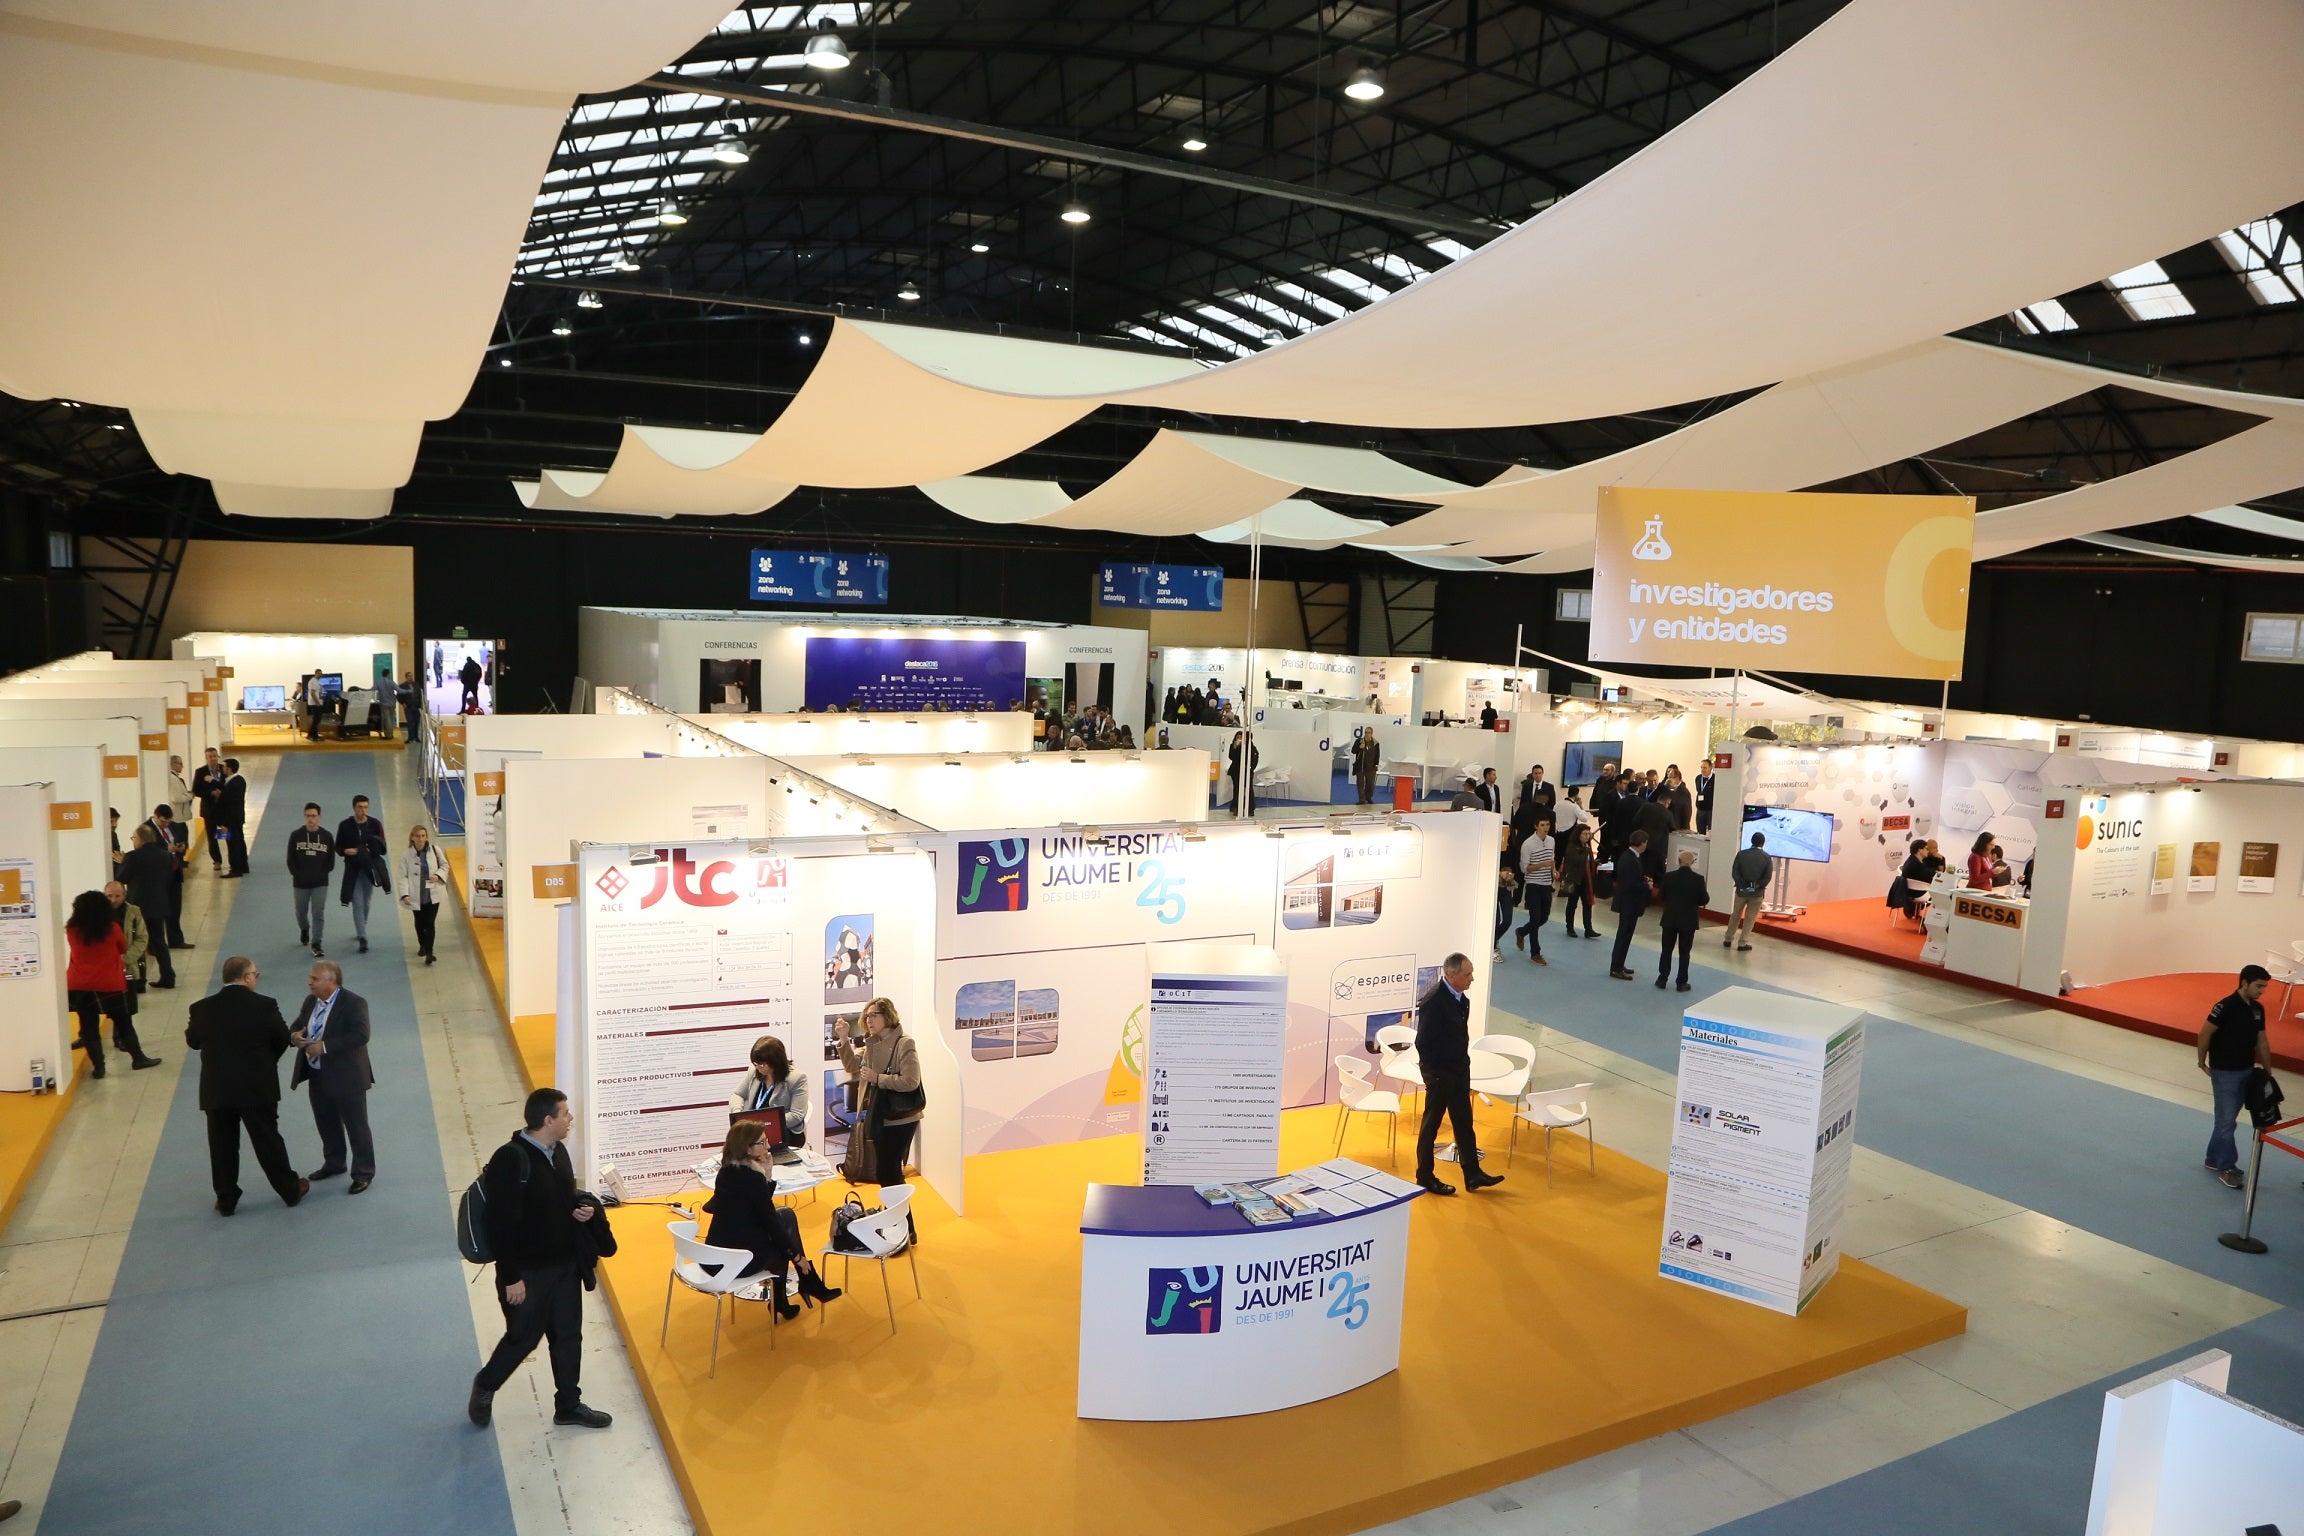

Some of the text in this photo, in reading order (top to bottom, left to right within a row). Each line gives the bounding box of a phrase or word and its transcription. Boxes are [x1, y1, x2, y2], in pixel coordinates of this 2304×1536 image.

[758, 576, 774, 584] zona
[758, 585, 793, 596] networking
[837, 589, 863, 599] networking
[1629, 578, 1833, 614] investigadores
[1157, 597, 1188, 606] networking
[1628, 615, 1788, 645] y entidades
[704, 641, 758, 649] CONFERENCIAS
[1069, 646, 1113, 654] CONFERENCIAS
[1281, 658, 1304, 669] prensa
[63, 812, 80, 821] E03
[1884, 818, 1909, 827] BECSA
[1042, 862, 1132, 887] JAUME I
[545, 877, 564, 886] D05
[1043, 892, 1062, 903] DES
[1065, 891, 1078, 901] DE
[1136, 860, 1186, 924] 25
[600, 903, 624, 912] AICE
[1958, 900, 2018, 925] BECSA
[1357, 973, 1410, 987] espaitec
[597, 1005, 667, 1016] CARACTERIZACIÓN
[597, 1032, 644, 1041] MATERIALES
[1689, 1028, 1738, 1047] Materiales
[597, 1071, 692, 1085] PROCESOS PRODUCTIVOS
[598, 1109, 639, 1118] PRODUCTO
[1718, 1110, 1750, 1123] SOLAR
[1723, 1122, 1762, 1137] PIGMENT
[598, 1143, 700, 1160] SISTEMAS CONSTRUCTIVOS
[1236, 1239, 1375, 1285] UNIVERSITAT
[1235, 1278, 1324, 1311] JAUME I
[1326, 1271, 1370, 1330] 25
[1236, 1309, 1295, 1325] DES DE 1991
